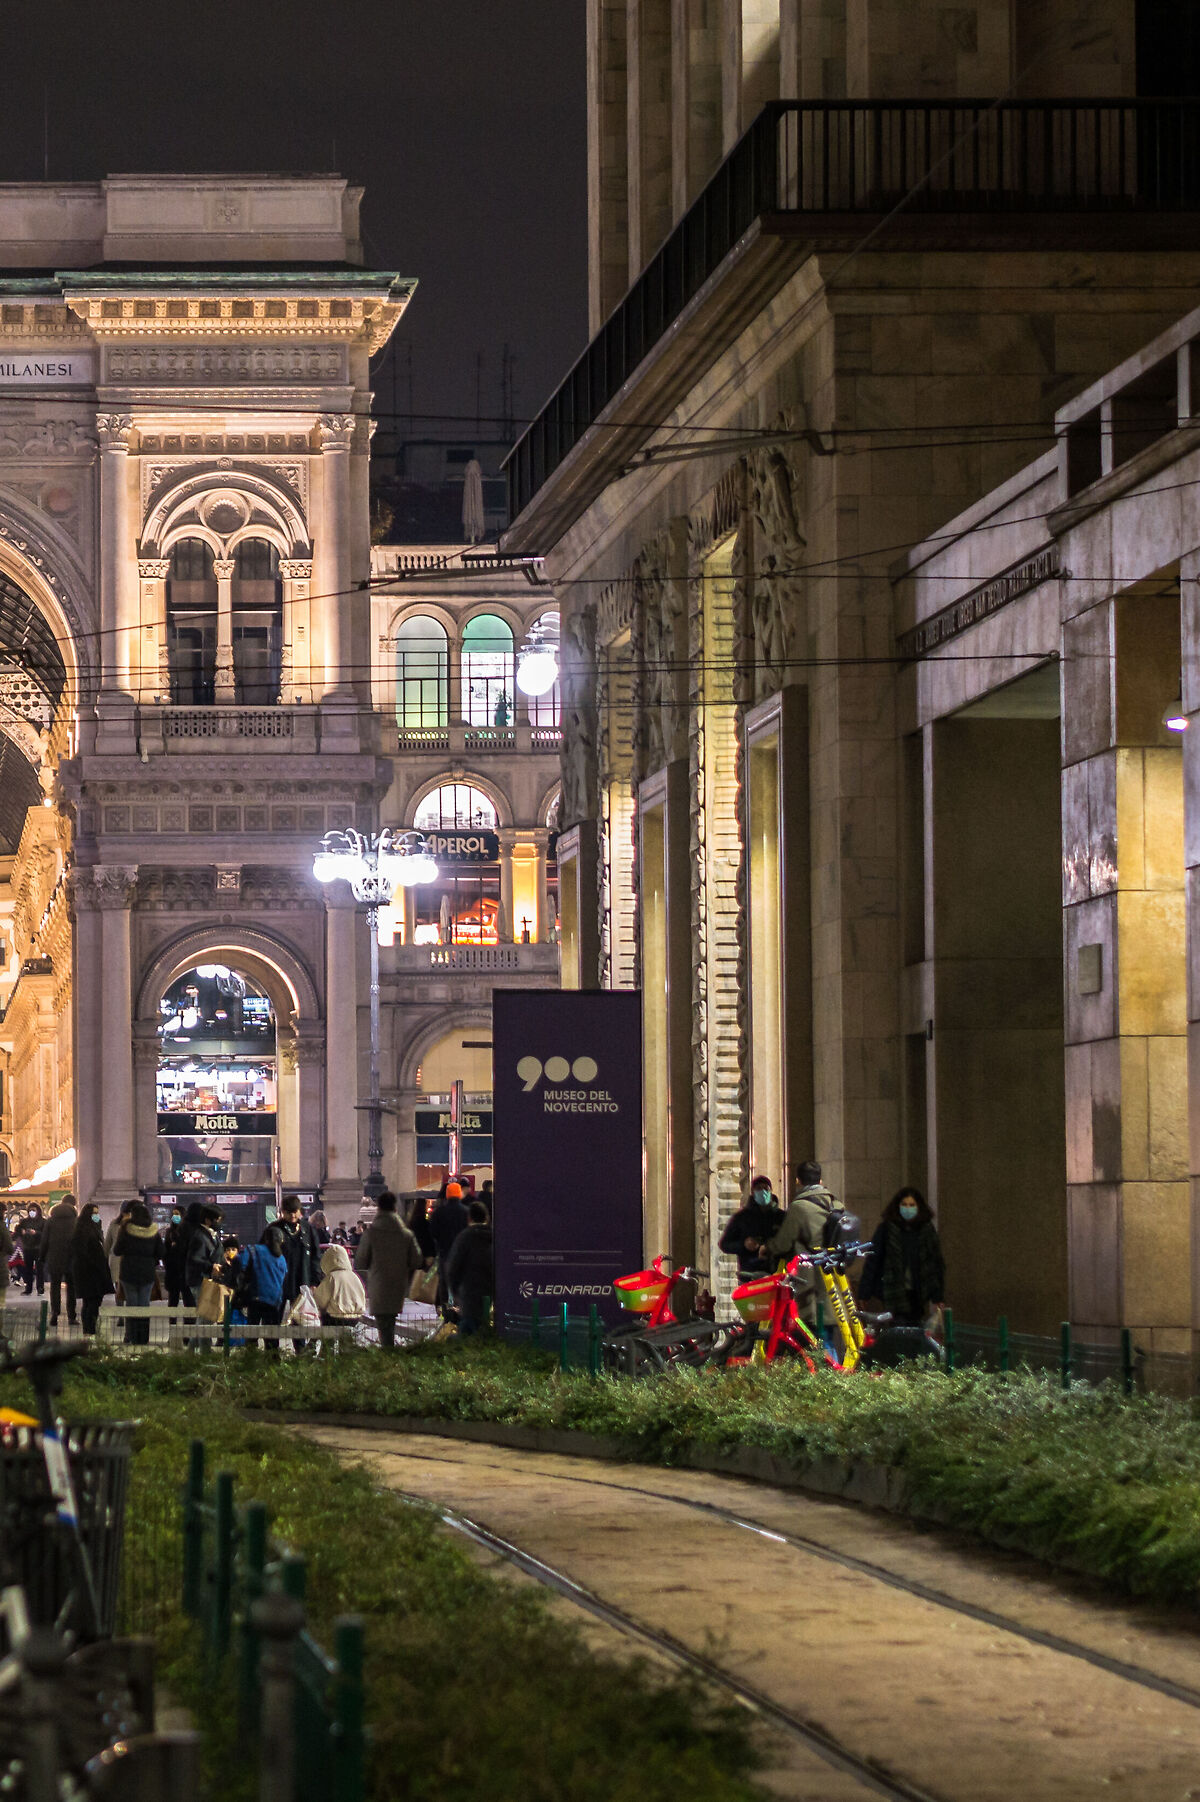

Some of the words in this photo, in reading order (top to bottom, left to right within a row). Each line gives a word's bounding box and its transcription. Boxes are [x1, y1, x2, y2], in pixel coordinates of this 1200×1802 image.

[426, 834, 489, 854] APEROL
[544, 1090, 587, 1101] MUSEO
[589, 1090, 612, 1101] DEL
[543, 1102, 619, 1113] NOVECENTO
[194, 1114, 239, 1130] Motta
[438, 1114, 482, 1129] Mtta
[536, 1285, 613, 1295] LEONARDO
